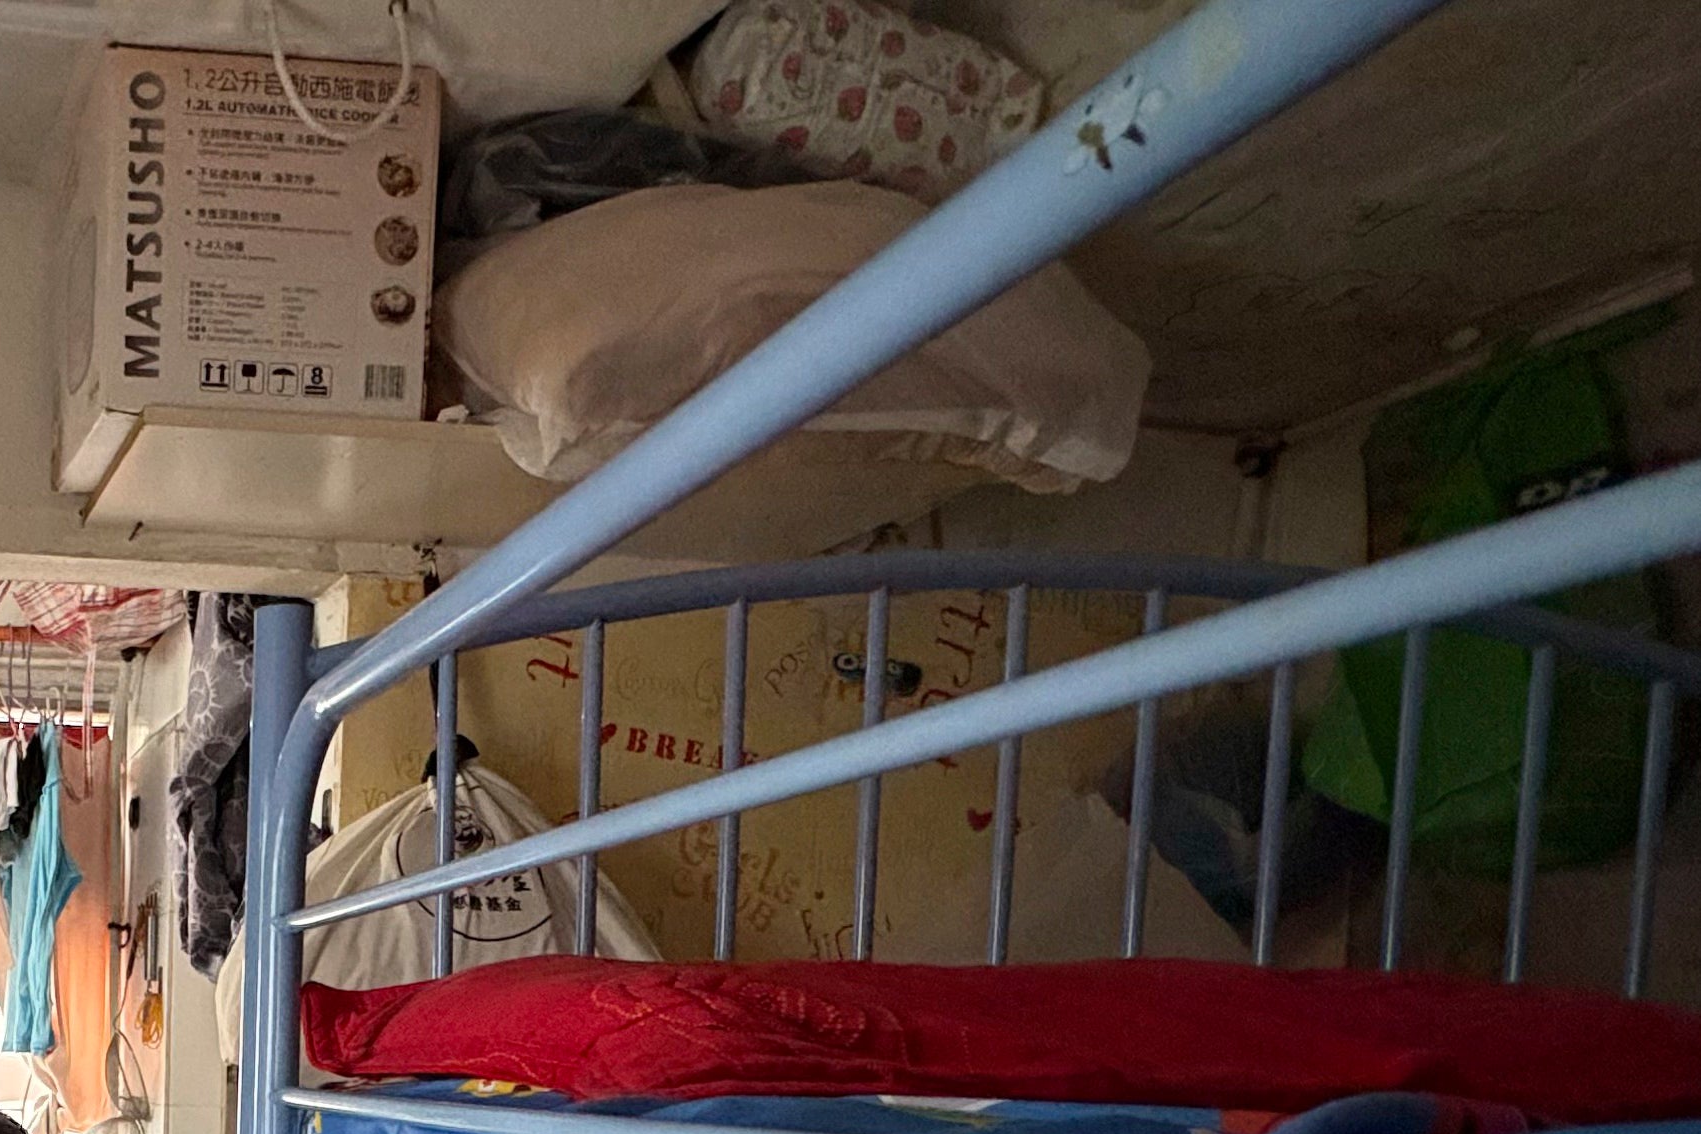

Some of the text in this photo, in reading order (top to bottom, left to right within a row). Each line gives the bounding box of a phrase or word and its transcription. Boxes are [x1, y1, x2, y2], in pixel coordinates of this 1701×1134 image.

[186, 99, 213, 111] 1.2L
[123, 70, 167, 379] MATSUSHO
[310, 366, 323, 385] 8
